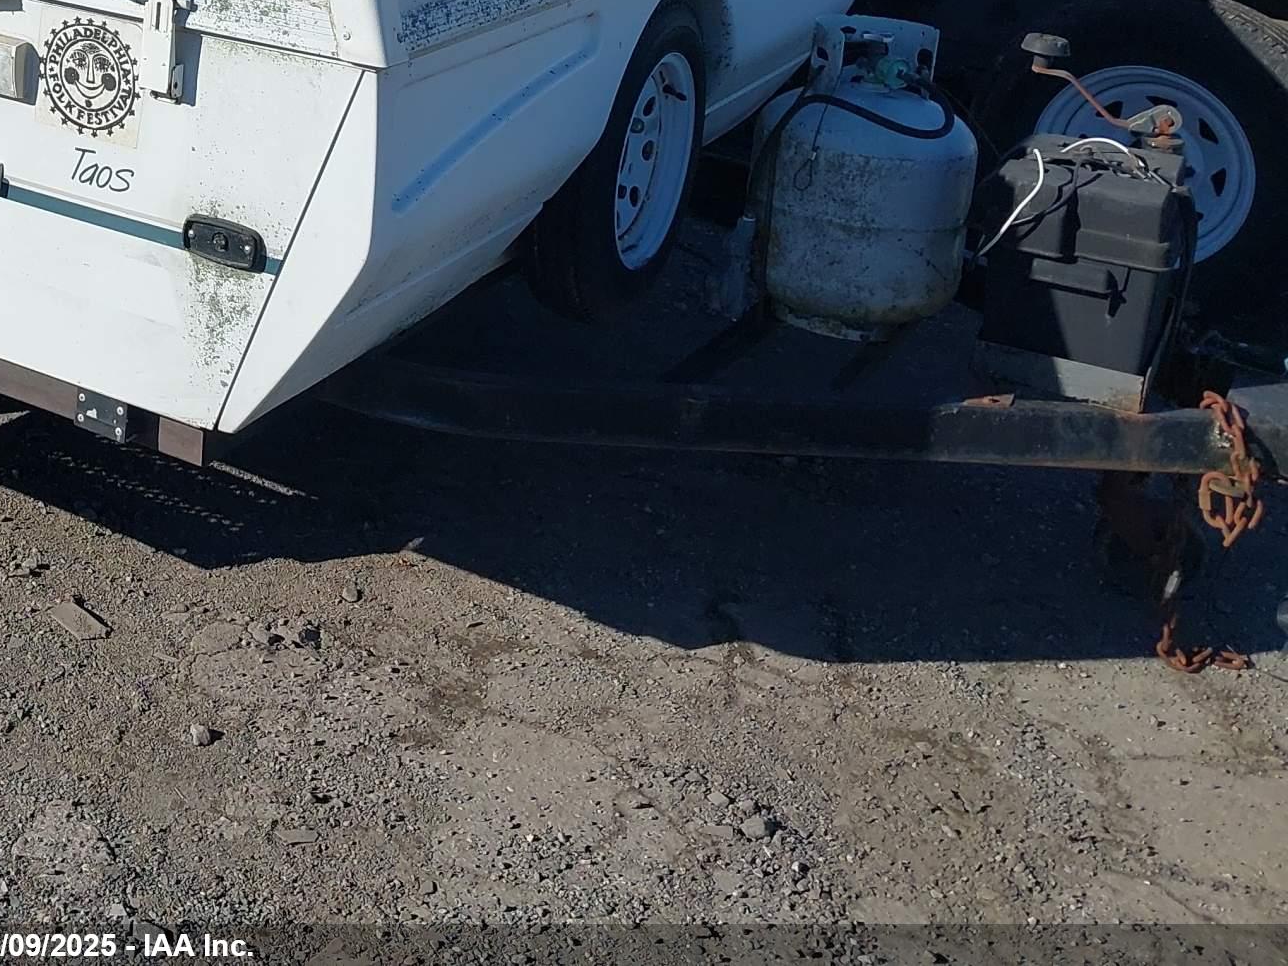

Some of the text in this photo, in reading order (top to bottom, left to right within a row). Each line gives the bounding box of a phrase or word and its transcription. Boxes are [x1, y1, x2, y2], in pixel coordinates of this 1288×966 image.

[48, 27, 132, 79] PHILADELPHIA
[48, 73, 133, 125] FOLK FESTIVAL
[69, 146, 136, 193] Taos
